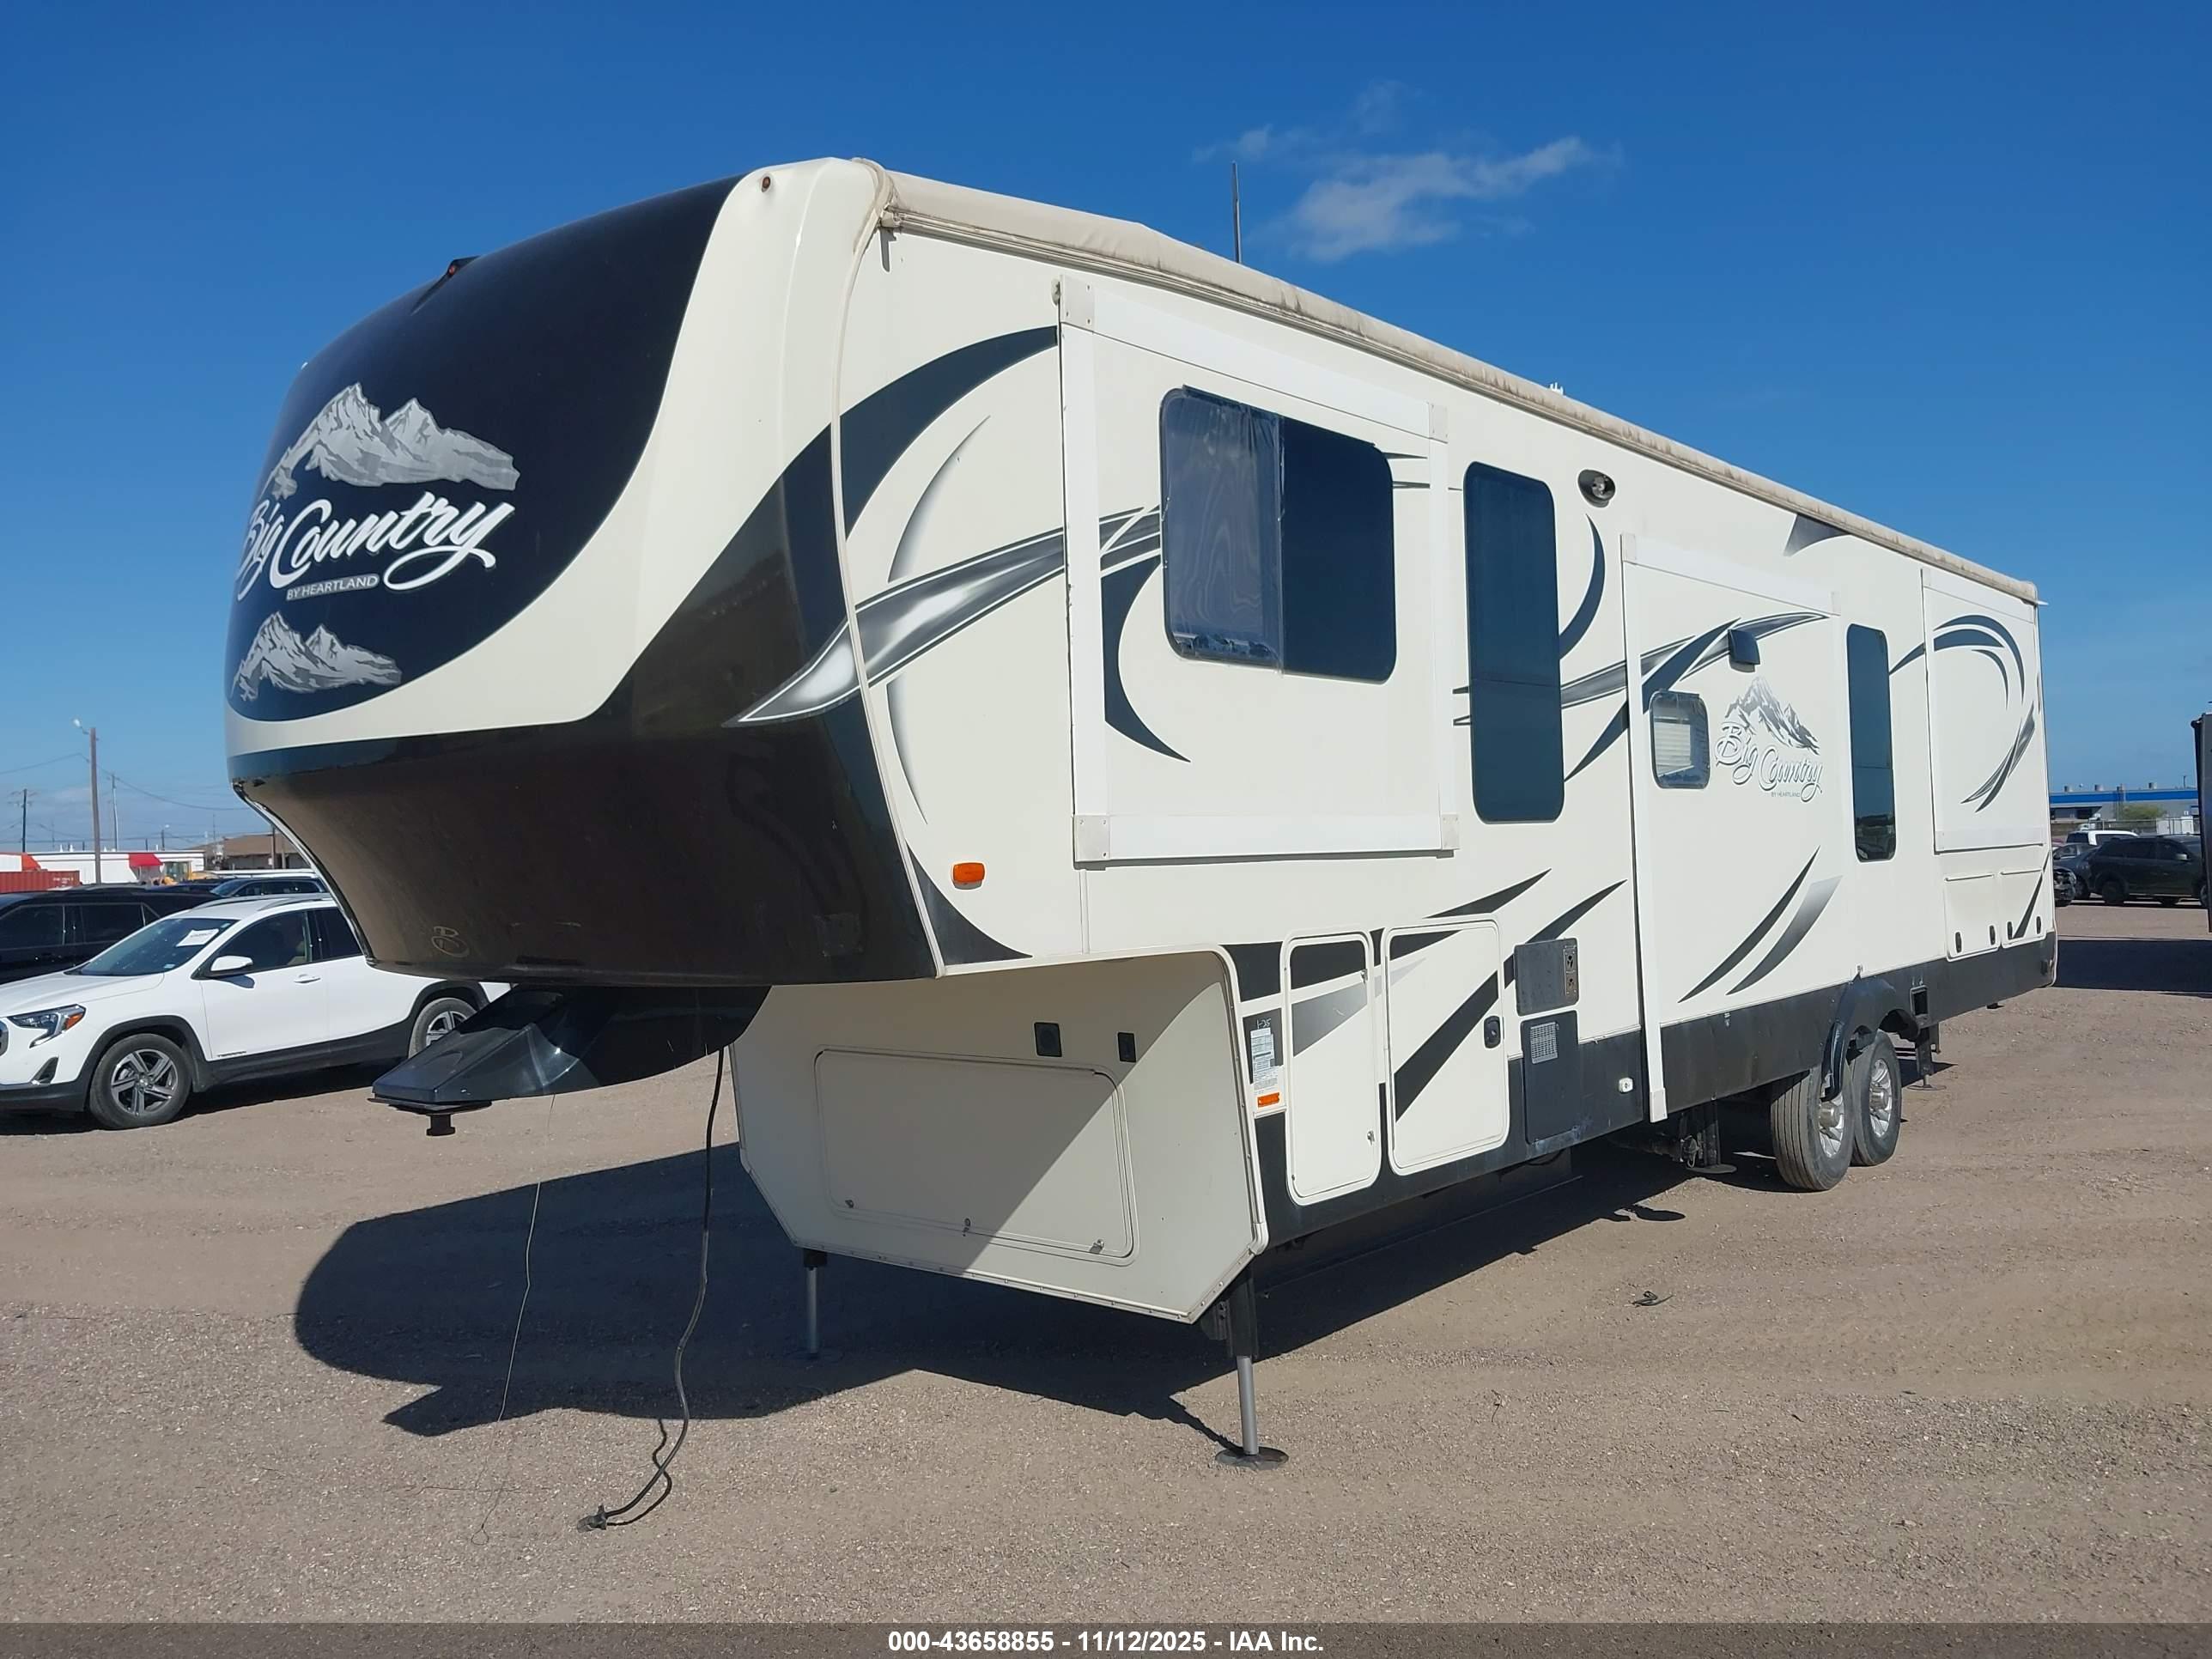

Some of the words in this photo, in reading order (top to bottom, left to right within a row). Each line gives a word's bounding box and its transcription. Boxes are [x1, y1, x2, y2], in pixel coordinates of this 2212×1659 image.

[235, 500, 284, 601] Big
[270, 491, 515, 591] Country
[287, 588, 301, 600] BY
[302, 576, 379, 595] HEARTLAND
[1714, 721, 1758, 786] Big
[1759, 744, 1823, 803] Country
